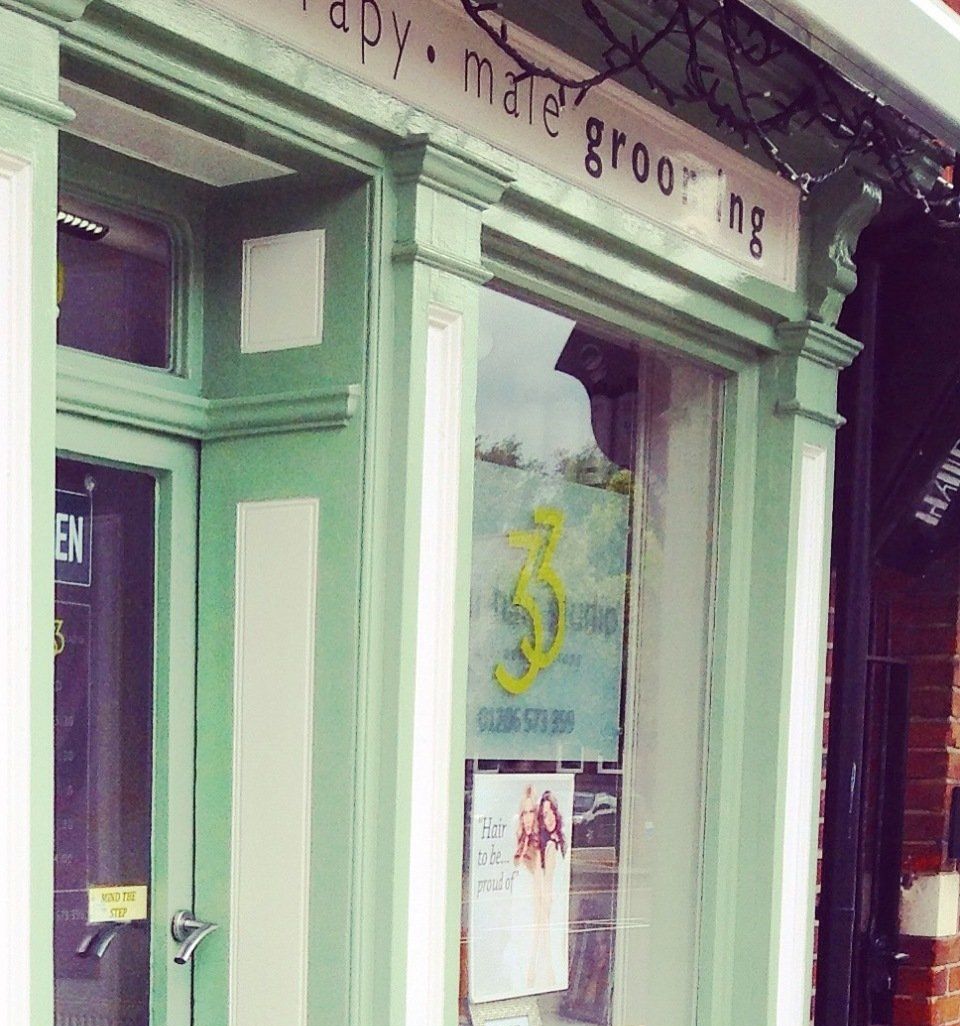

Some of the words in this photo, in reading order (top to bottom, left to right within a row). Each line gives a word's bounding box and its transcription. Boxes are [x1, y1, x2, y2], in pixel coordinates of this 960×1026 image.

[301, 0, 412, 81] apy
[464, 48, 560, 138] male
[477, 849, 488, 866] to
[476, 871, 503, 898] proud
[122, 890, 137, 902] THE
[110, 907, 128, 918] STEP
